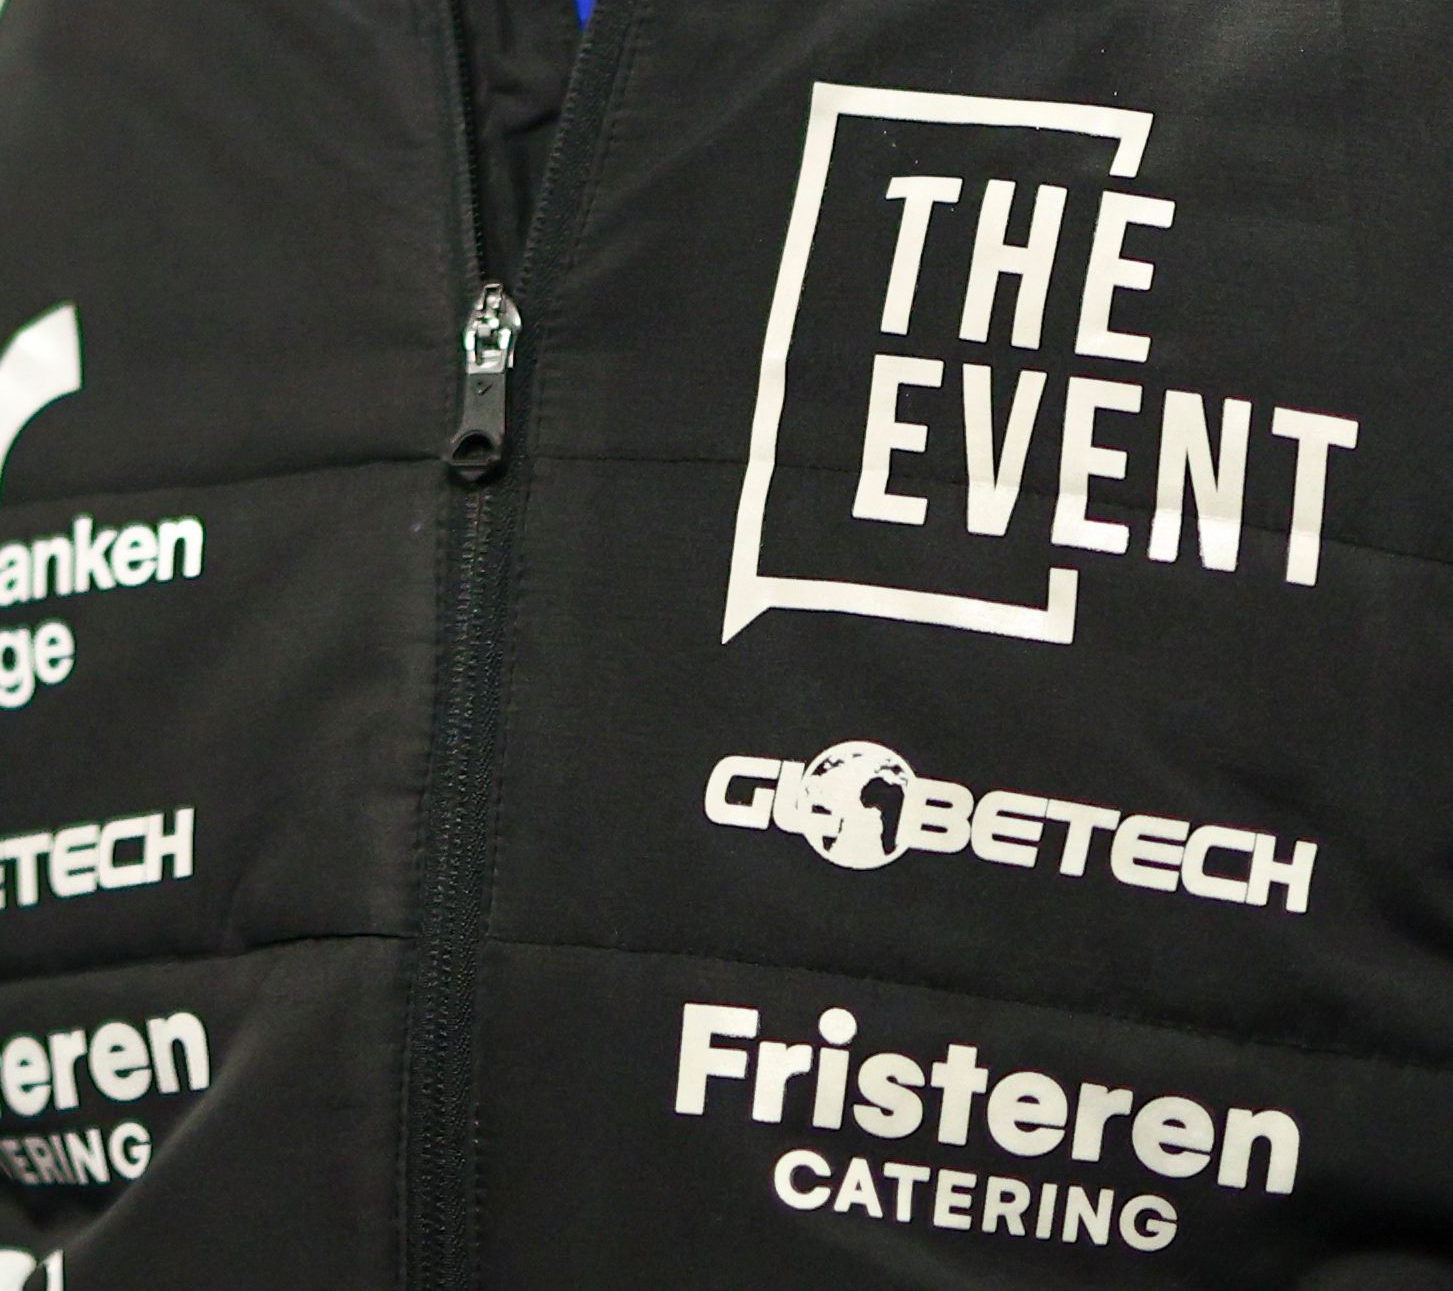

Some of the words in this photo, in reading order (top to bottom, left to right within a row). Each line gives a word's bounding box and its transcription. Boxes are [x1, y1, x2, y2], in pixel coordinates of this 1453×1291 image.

[880, 175, 1176, 363] THE
[851, 354, 1359, 587] EVENT
[674, 1002, 1300, 1195] Fristeren
[773, 1149, 1179, 1253] CATERING
